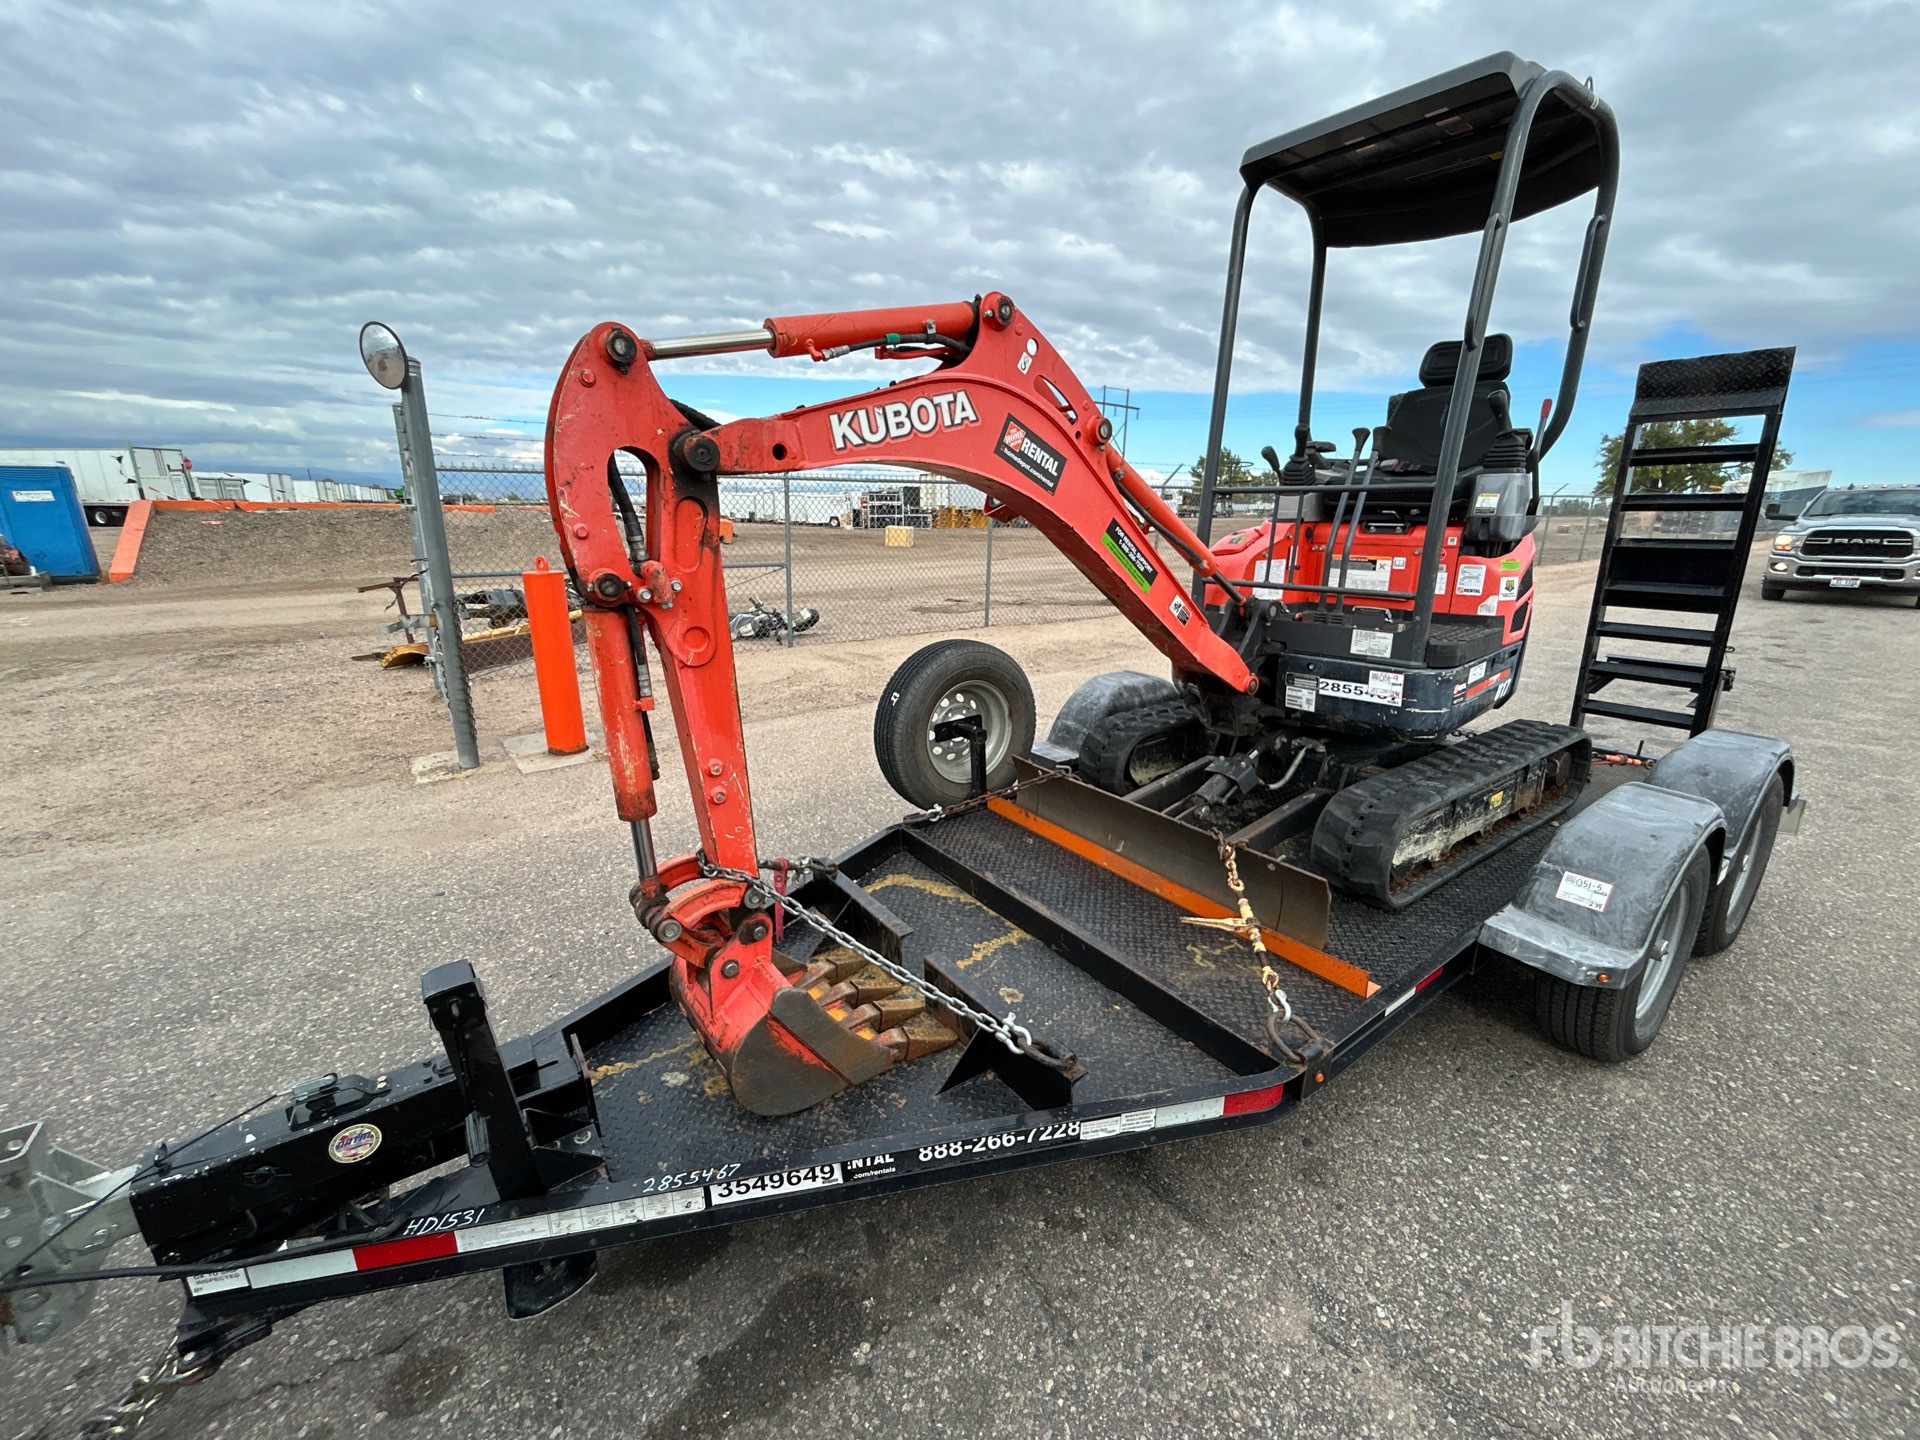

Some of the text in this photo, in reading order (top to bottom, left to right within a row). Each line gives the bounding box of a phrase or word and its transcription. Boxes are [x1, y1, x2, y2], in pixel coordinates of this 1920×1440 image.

[829, 389, 977, 450] KUBOTA
[1003, 447, 1055, 488] homedepot.com/rental
[1020, 437, 1059, 477] RENTAL
[1115, 526, 1153, 573] FOR RENTAL SUPPORT
[642, 1163, 741, 1194] 2855467
[717, 1163, 836, 1198] 3549649
